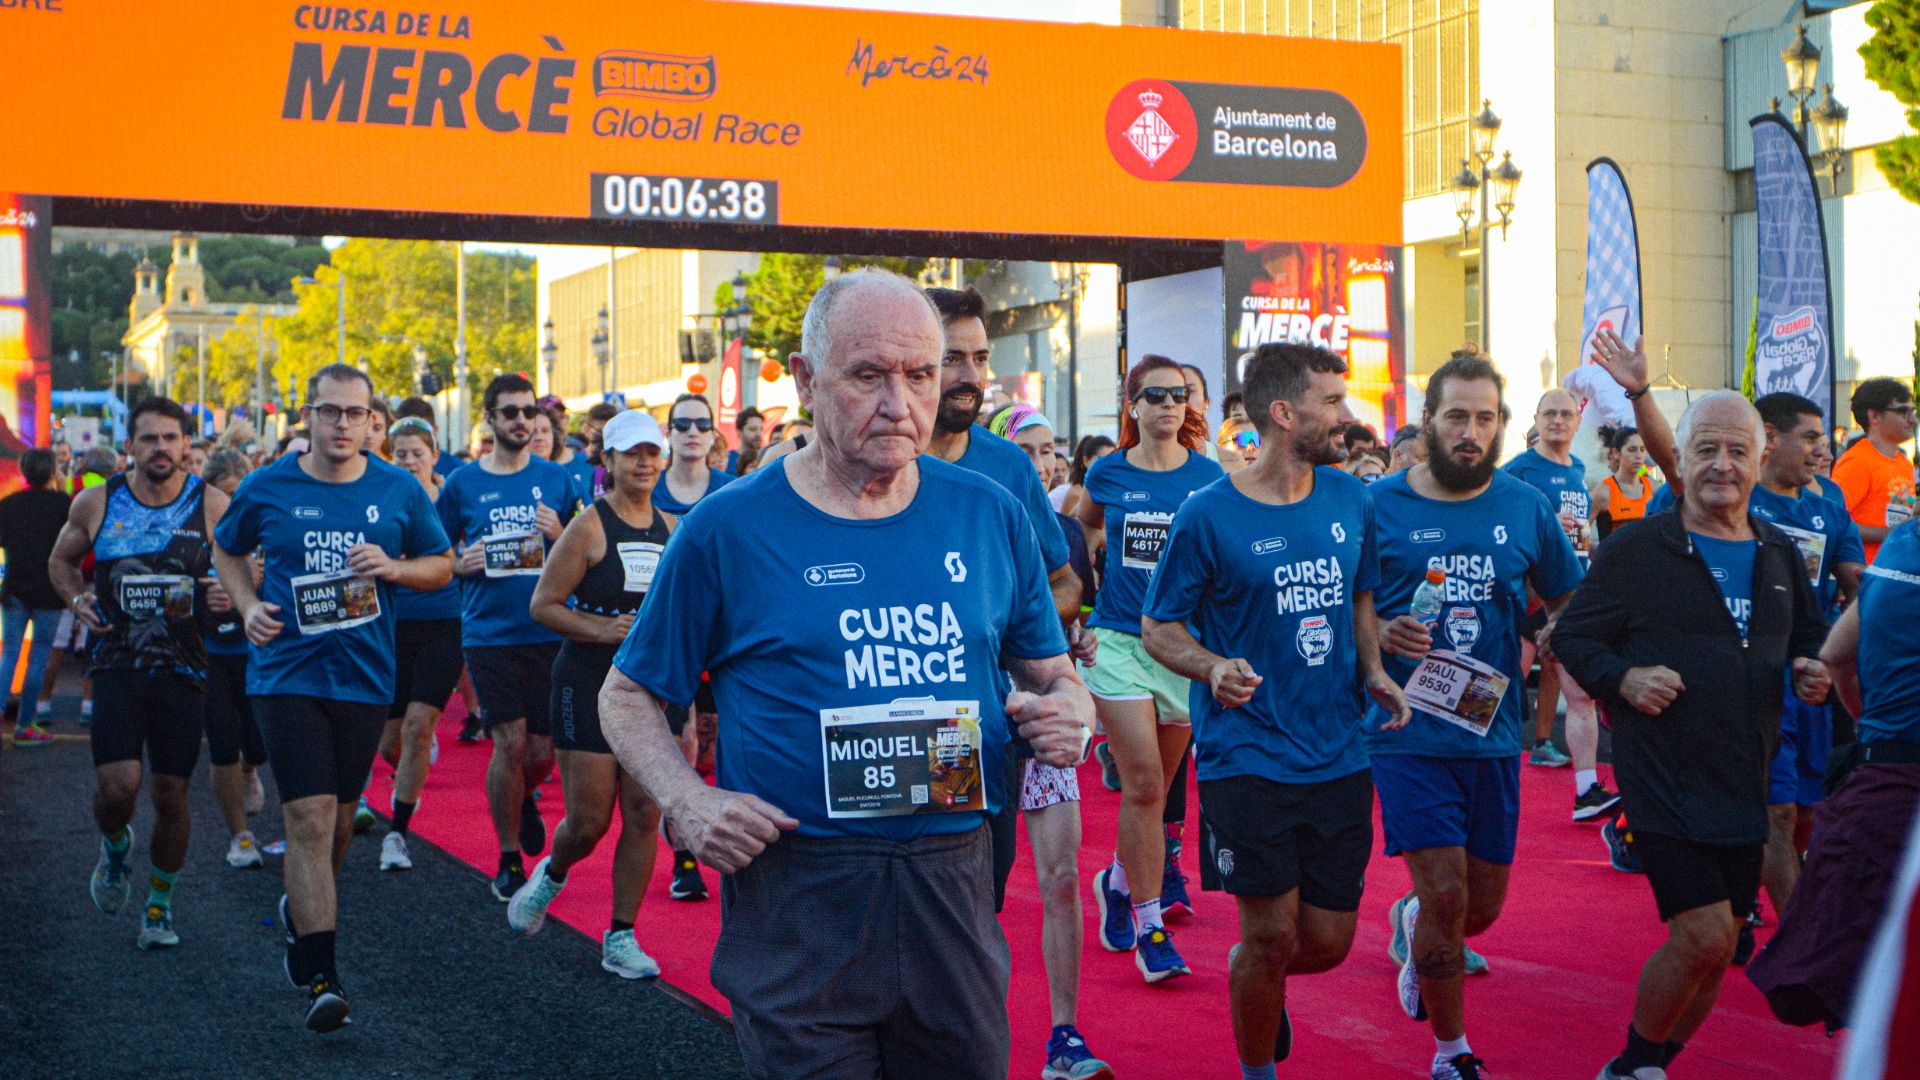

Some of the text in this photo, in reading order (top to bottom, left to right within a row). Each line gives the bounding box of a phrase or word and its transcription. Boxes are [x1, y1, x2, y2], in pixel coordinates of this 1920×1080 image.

[294, 5, 471, 39] CURSA DE LA
[281, 34, 577, 134] MERCÈ
[600, 60, 711, 93] BIMBO
[592, 106, 801, 146] Global Race
[1213, 106, 1337, 131] Ajuntament de
[1213, 130, 1338, 161] Barcelona
[603, 174, 767, 222] 00:06:38
[1241, 296, 1311, 311] CURSA DE LA
[1238, 305, 1350, 350] MERCÈ
[1561, 490, 1589, 507] CURSA
[489, 505, 537, 522] CURSA
[304, 530, 366, 553] CURSA
[1126, 526, 1168, 540] MARTA
[486, 542, 520, 552] CARLOS
[1132, 540, 1160, 552] 4617
[1274, 555, 1343, 587] CURSA
[126, 586, 161, 598] DAVID
[300, 586, 336, 603] JUAN
[1276, 579, 1344, 616] MERCÈ
[1442, 575, 1496, 601] ERCÈ
[304, 600, 337, 616] 8689
[839, 601, 964, 646] CURSA
[844, 637, 967, 690] MERCÈ
[1423, 660, 1458, 683] RAÚL
[1418, 675, 1451, 695] 9530
[831, 736, 925, 762] MIQUEL
[863, 765, 896, 789] 85
